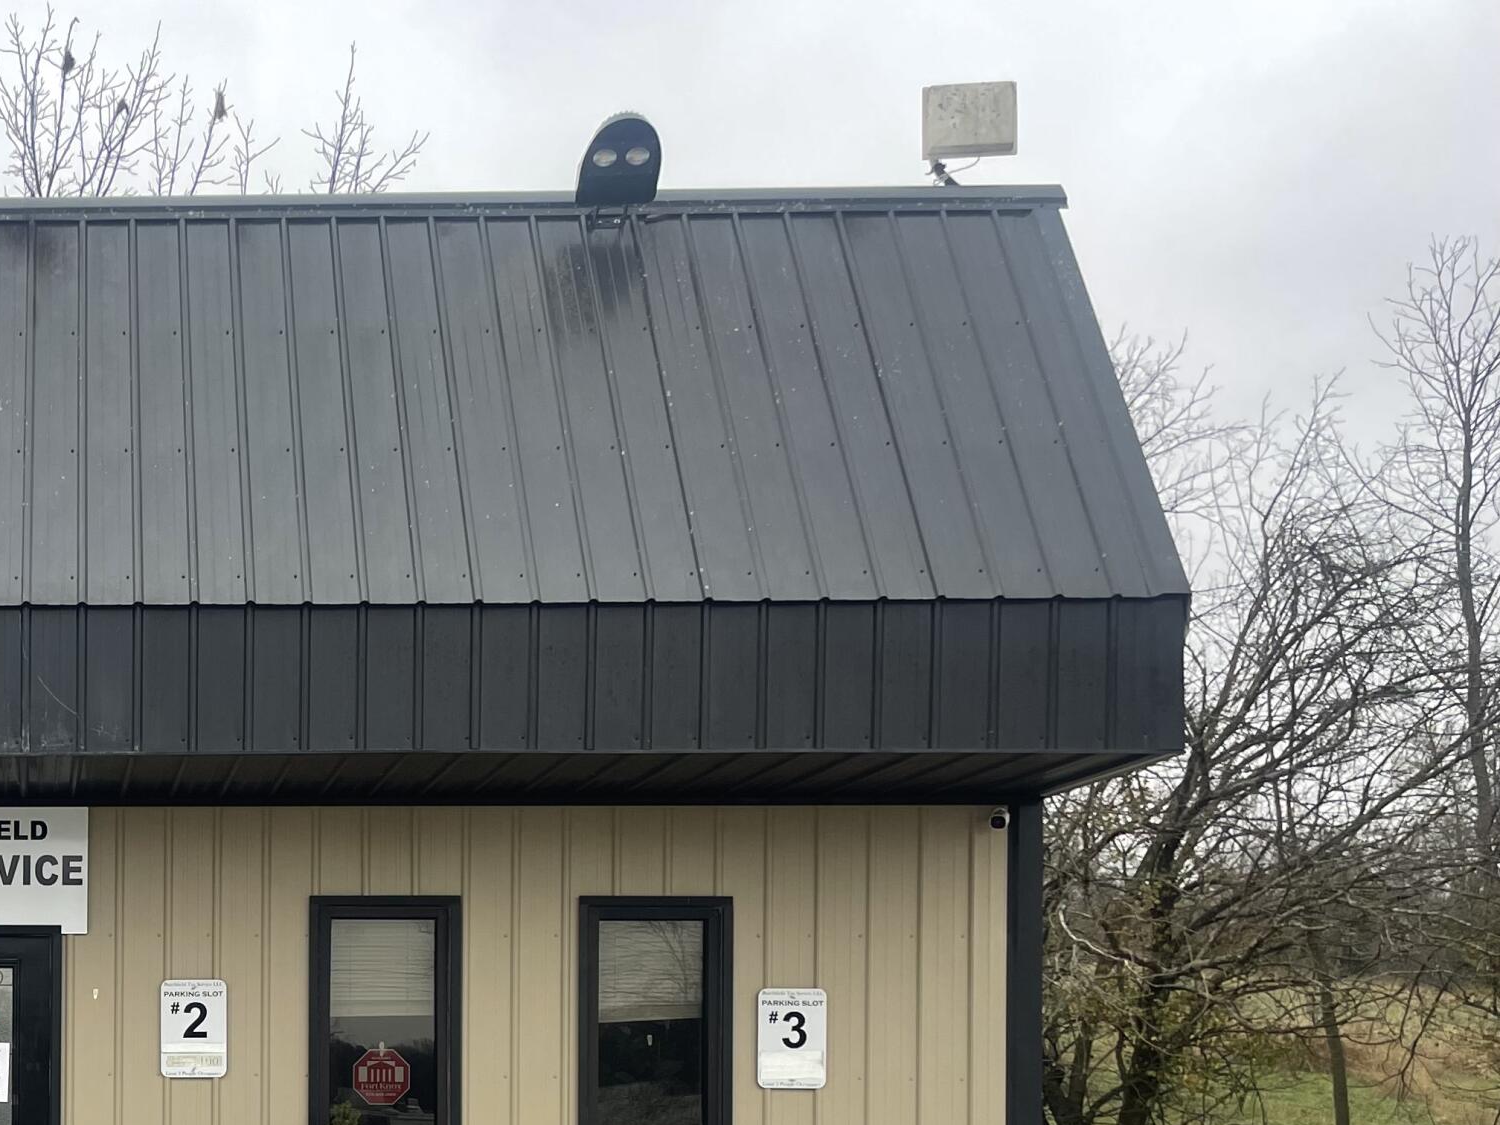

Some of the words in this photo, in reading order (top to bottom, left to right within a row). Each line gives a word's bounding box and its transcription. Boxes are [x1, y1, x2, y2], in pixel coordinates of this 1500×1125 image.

[163, 990, 201, 998] PARKING
[202, 990, 223, 998] SLOT
[761, 999, 800, 1007] PARKING
[801, 999, 824, 1007] SLOT
